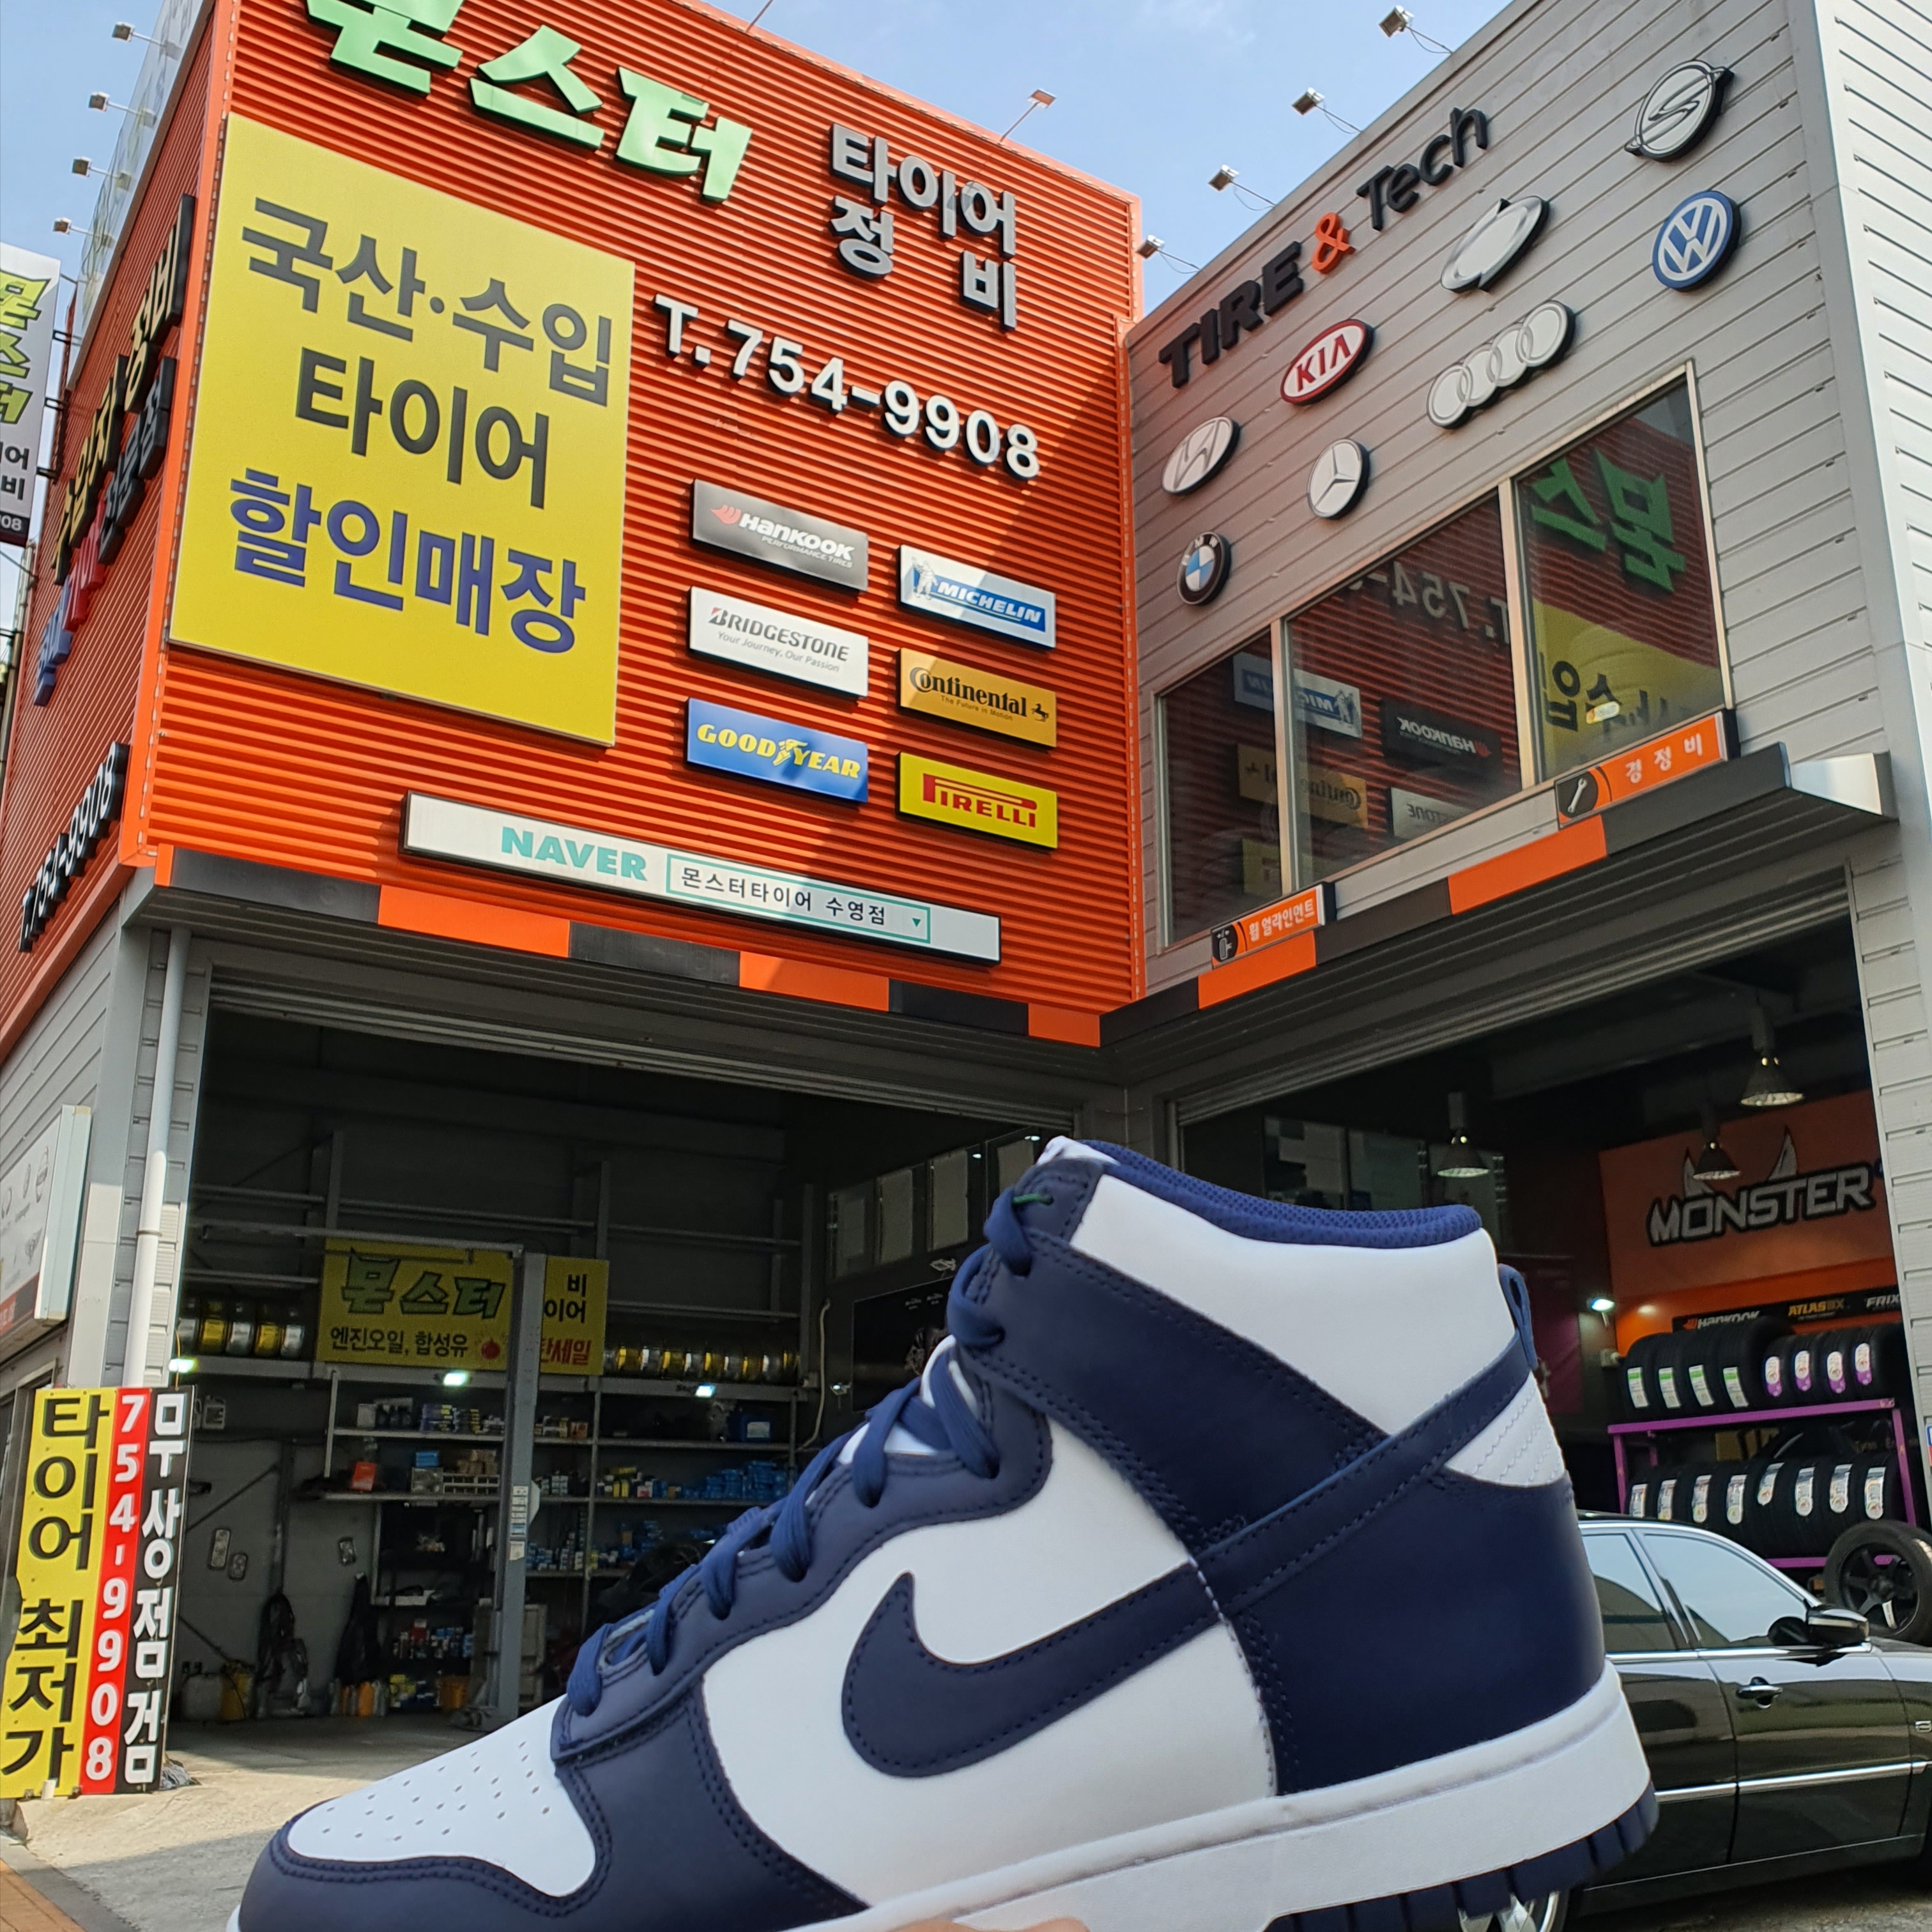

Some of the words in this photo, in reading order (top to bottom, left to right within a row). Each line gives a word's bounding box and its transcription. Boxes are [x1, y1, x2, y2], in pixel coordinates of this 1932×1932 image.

[832, 122, 1016, 257] 타이어
[1158, 241, 1304, 389] TIRE
[1312, 211, 1356, 274] &
[1356, 107, 1488, 231] Tech
[654, 293, 1041, 480] T.754-9908
[1296, 333, 1351, 393] KIA
[295, 346, 549, 510] 타이어
[230, 467, 586, 654] 할인매장
[761, 535, 827, 561] PERFORMANCE
[826, 555, 854, 569] TIRES
[937, 581, 1042, 624] MICHELIN
[709, 607, 850, 662] BRIDGESTONE
[717, 630, 740, 645] Your
[785, 649, 804, 663] Our
[804, 656, 840, 673] Passion
[909, 666, 1027, 717] Continental
[940, 694, 954, 705] The
[956, 699, 979, 712] Future
[990, 709, 1013, 721] Motion
[922, 772, 1038, 829] PIRELLI
[500, 825, 648, 882] NAVER
[680, 866, 813, 913] 몬스터타이어
[825, 895, 886, 927] 수영점
[1648, 1165, 1874, 1245] MONSTER
[341, 1246, 506, 1319] 몬스터
[544, 1298, 586, 1323] 이어
[415, 1331, 468, 1358] 합성유
[29, 1393, 109, 1571] 타이어
[86, 1394, 145, 1781] 754-9908
[124, 1393, 187, 1784] 무상점검
[1, 1598, 84, 1788] 최저가
